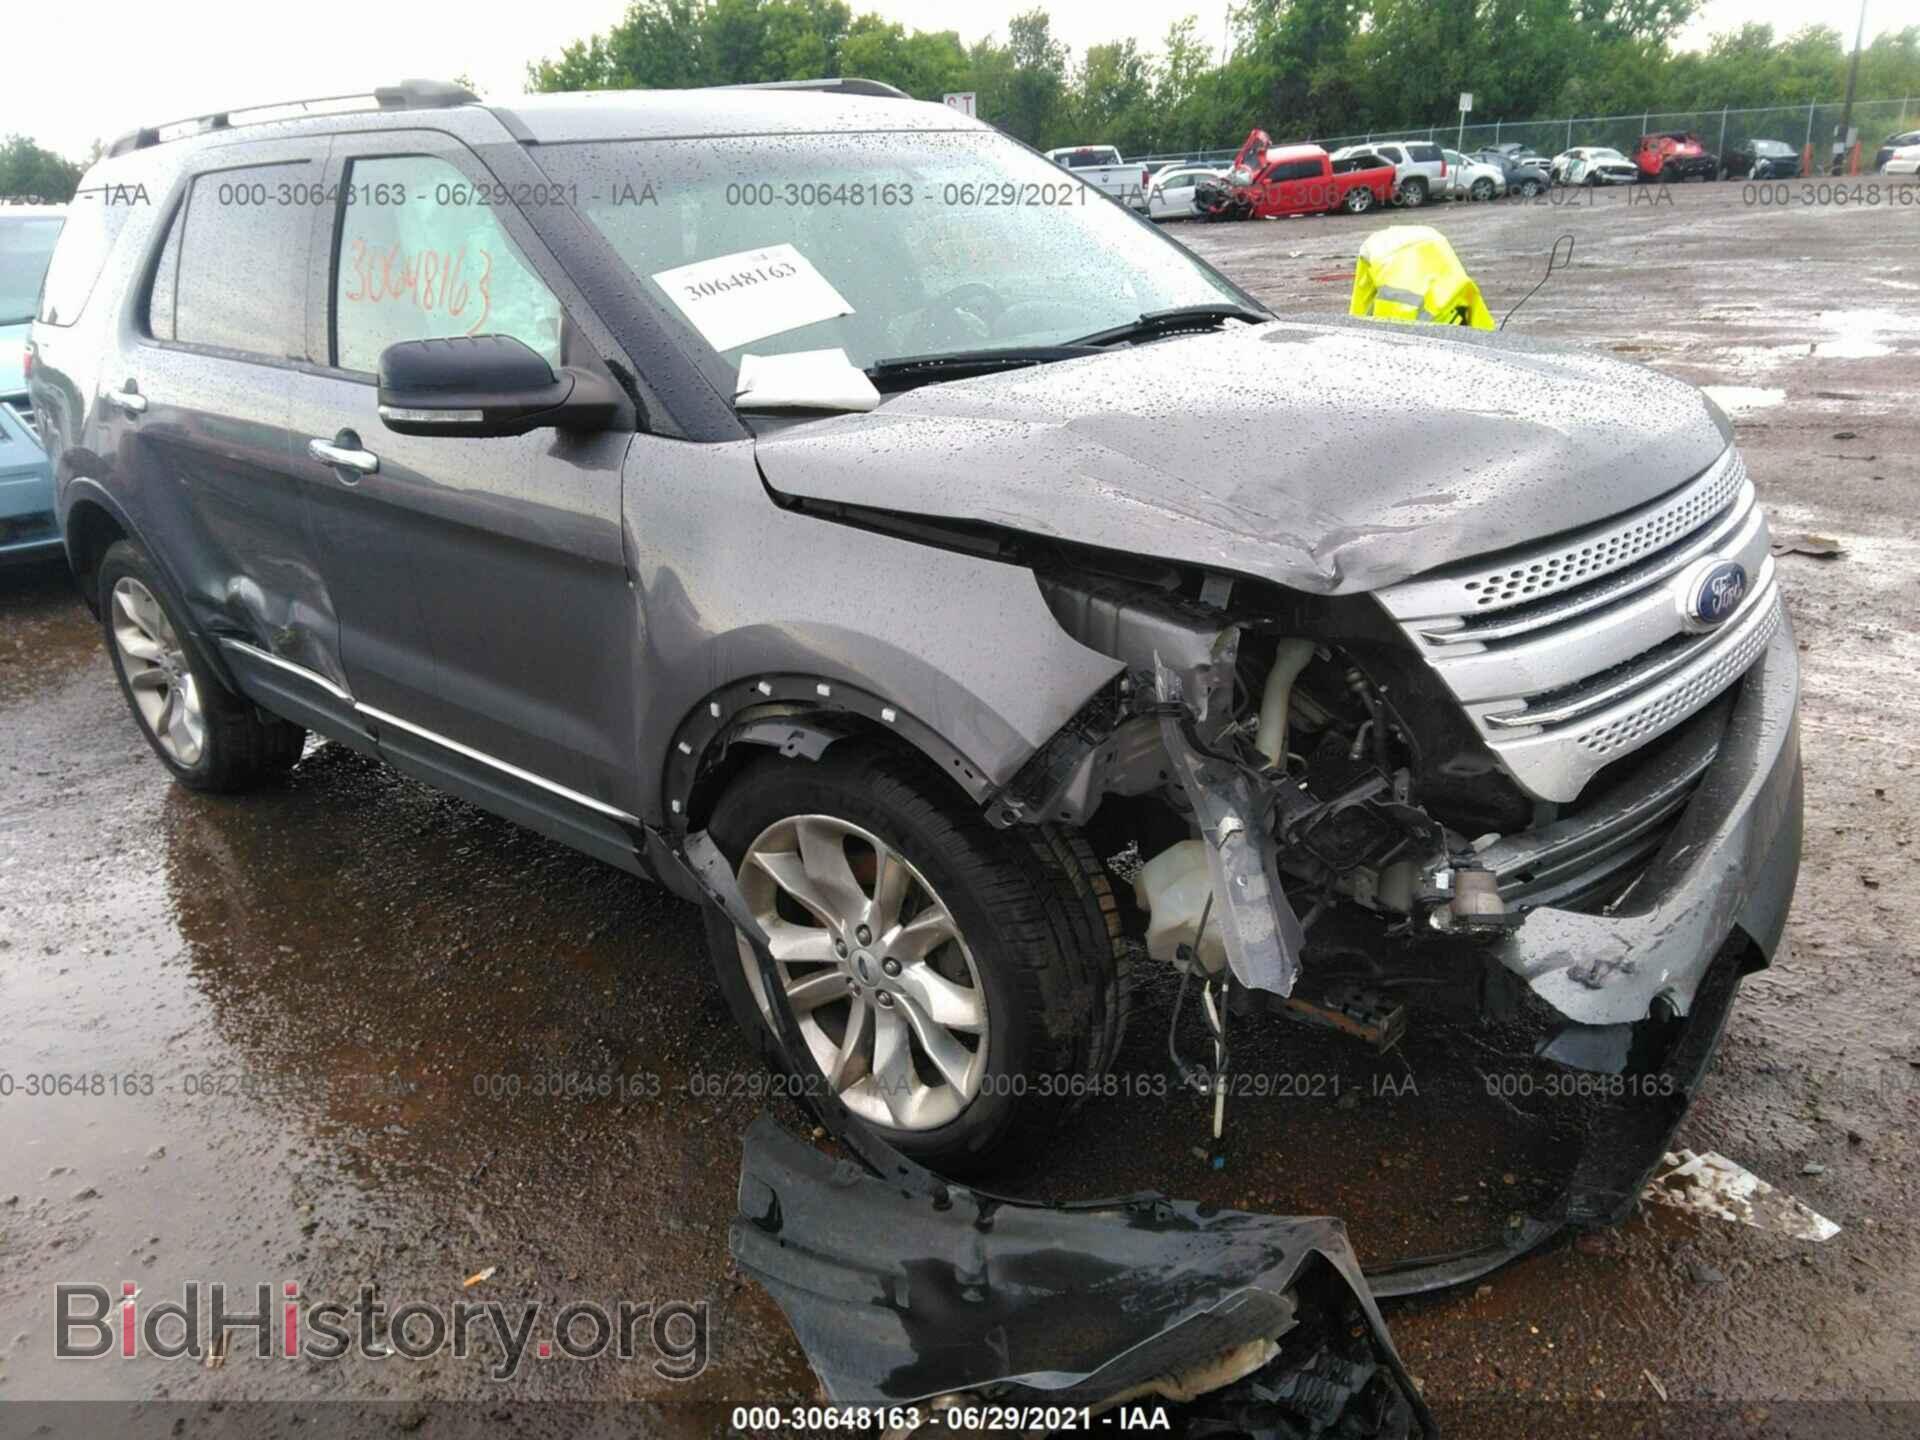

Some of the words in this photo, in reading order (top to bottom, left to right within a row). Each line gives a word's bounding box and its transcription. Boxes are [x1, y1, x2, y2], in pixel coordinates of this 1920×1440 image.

[345, 239, 493, 337] 30648163
[684, 262, 798, 302] 30648163
[1711, 571, 1744, 615] Ford
